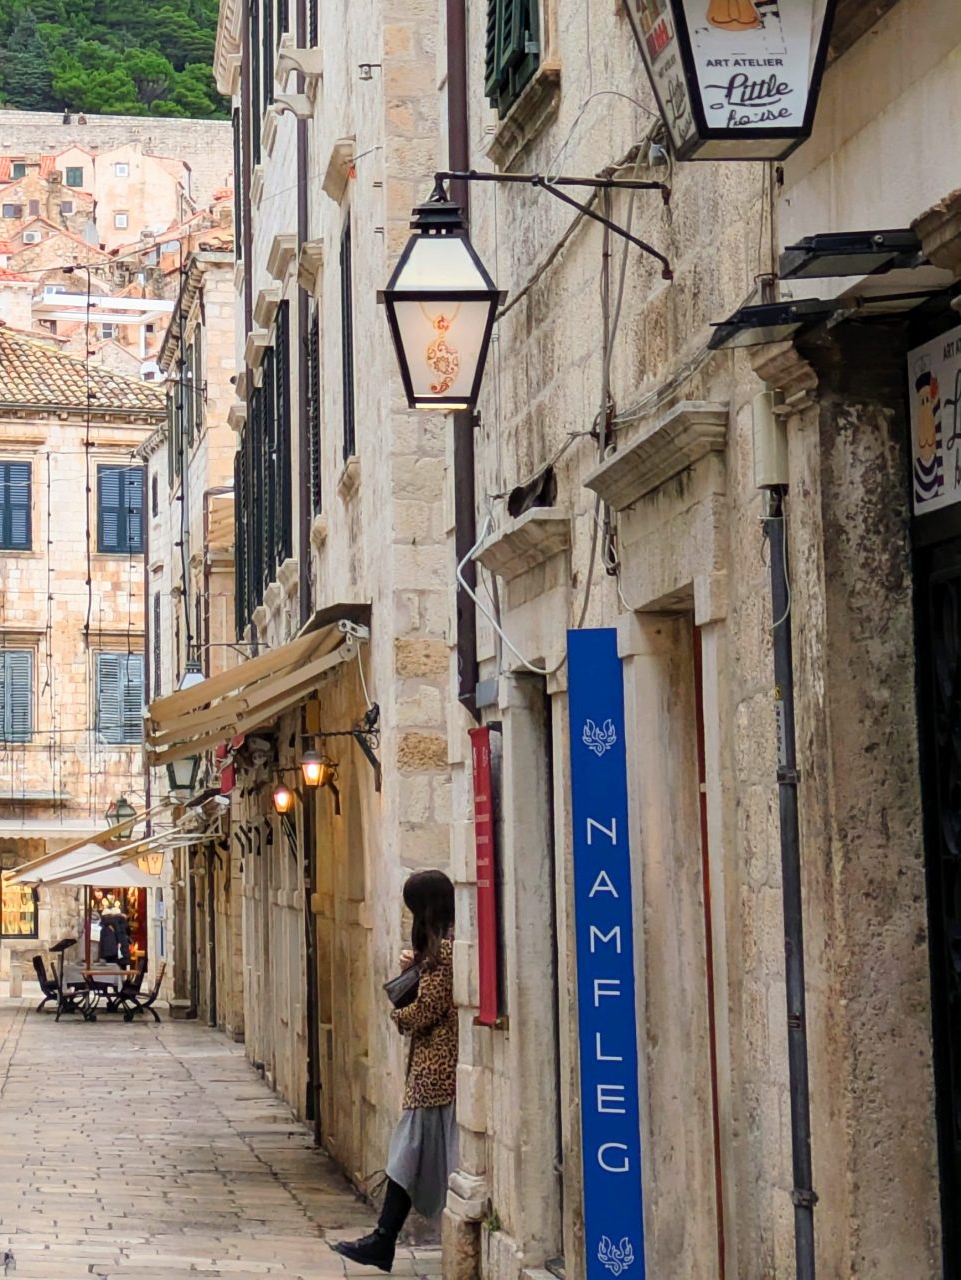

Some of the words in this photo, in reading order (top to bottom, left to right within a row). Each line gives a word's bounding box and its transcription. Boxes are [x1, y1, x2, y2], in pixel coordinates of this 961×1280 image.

[705, 59, 730, 67] ART
[733, 59, 783, 67] ATELIER
[704, 73, 794, 107] Little
[586, 816, 631, 1174] NAMFLEG
